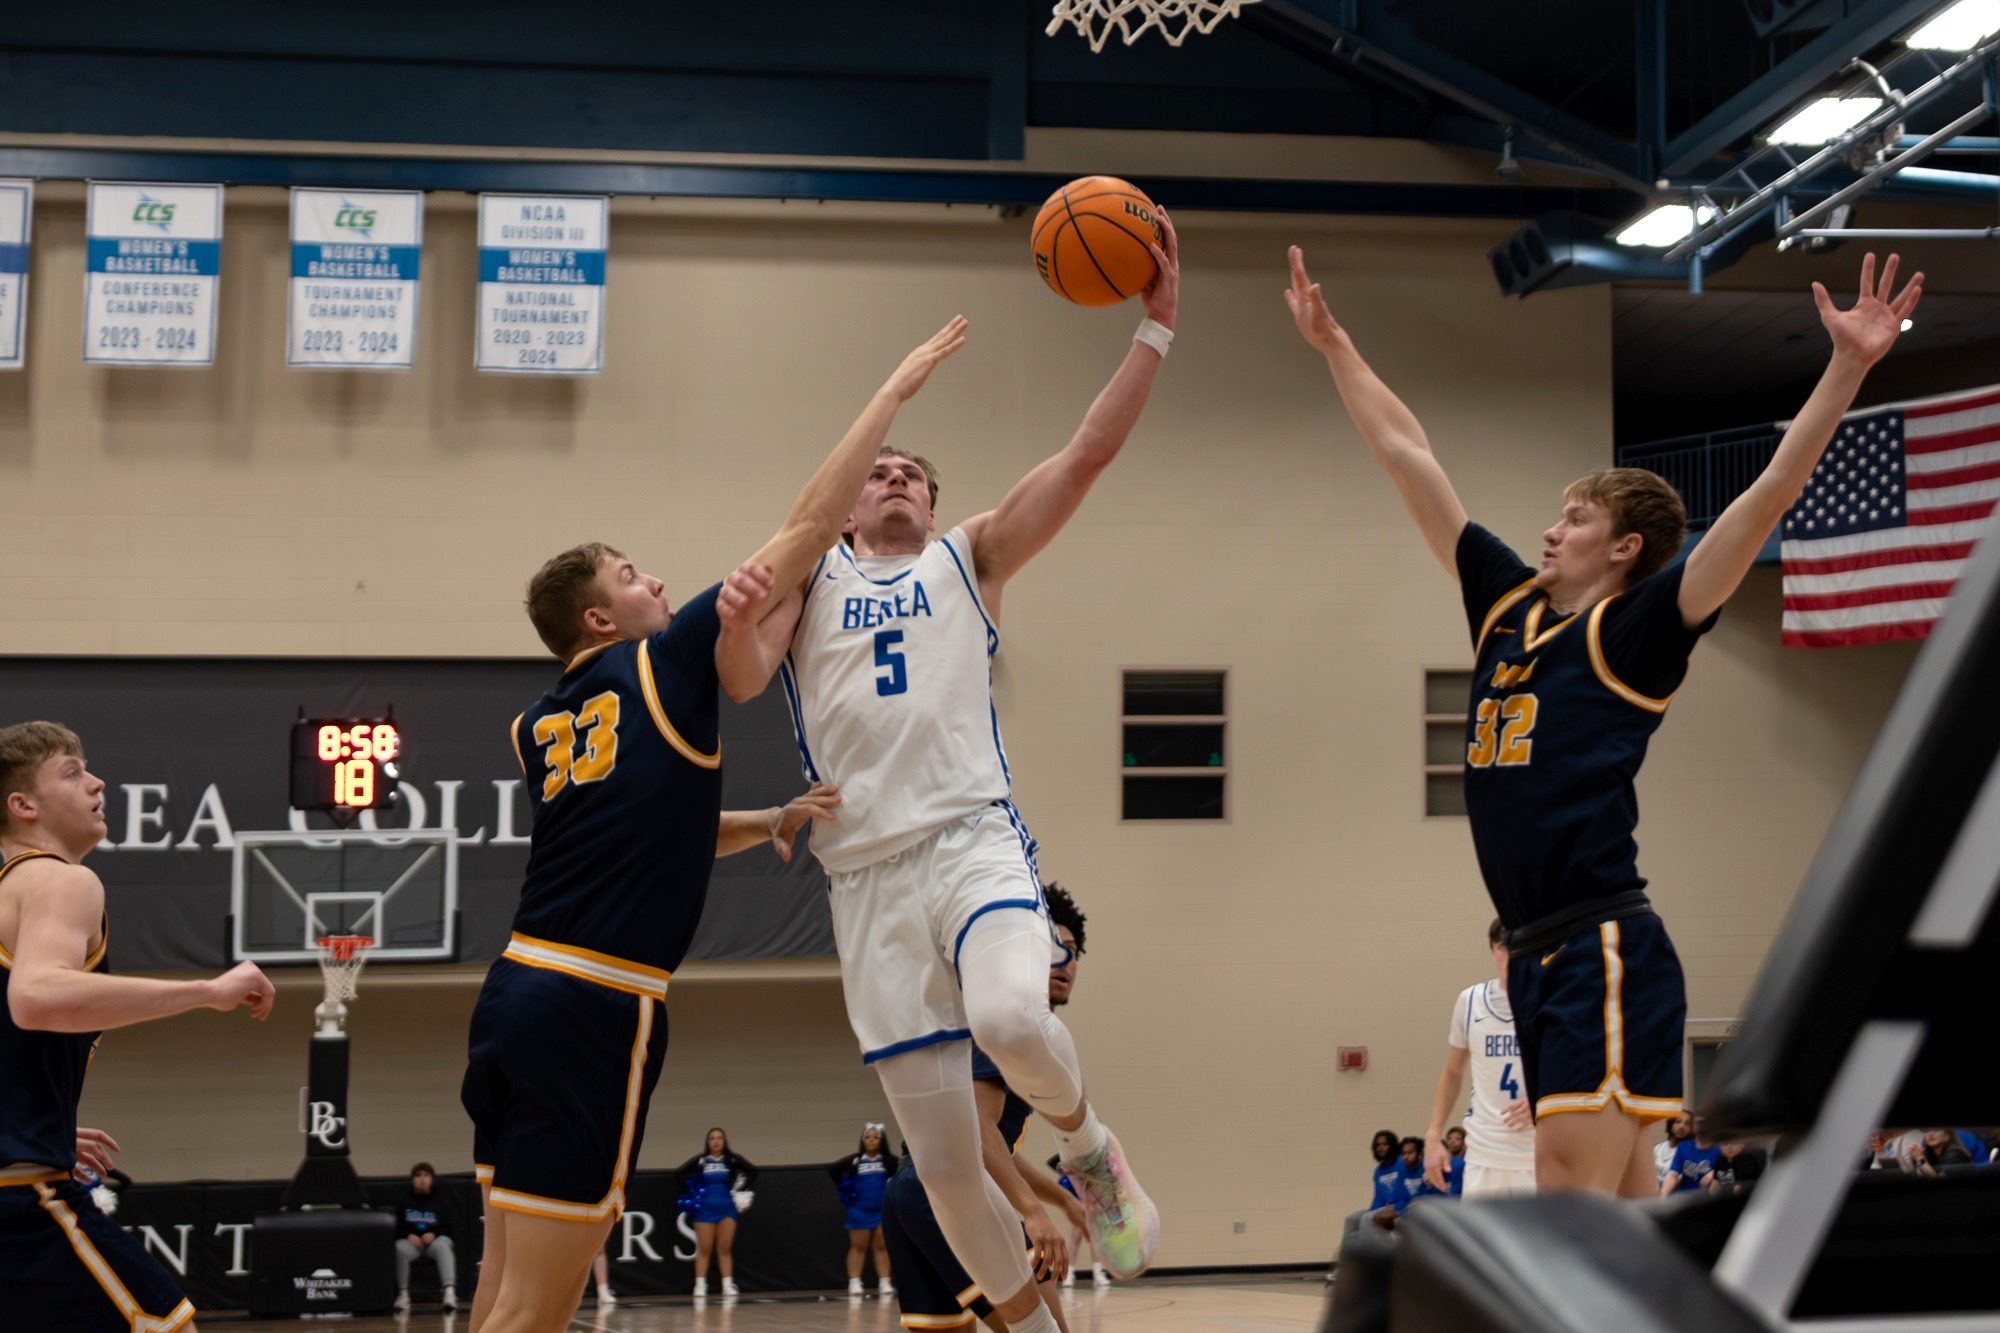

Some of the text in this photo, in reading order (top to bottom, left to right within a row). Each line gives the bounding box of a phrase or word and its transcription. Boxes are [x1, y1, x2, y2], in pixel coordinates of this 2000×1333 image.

[133, 203, 176, 221] CCS
[334, 210, 377, 228] CCS
[521, 205, 565, 222] NCAA
[501, 225, 584, 241] DIVISION III
[118, 240, 189, 256] WOMEN'S
[320, 246, 390, 261] WOMEN'S
[105, 257, 199, 273] BASKETBALL
[509, 251, 576, 266] WOMEN'S
[307, 262, 400, 278] BASKETBALL
[497, 267, 586, 283] BASKETBALL
[103, 281, 200, 297] CONFERENCE
[304, 286, 403, 301] TOURNAMENT
[106, 299, 195, 315] CHAMPIONS
[505, 291, 576, 307] NATIONAL
[309, 304, 397, 320] CHAMPIONS
[492, 308, 589, 324] TOURNAMENT
[100, 326, 140, 348] 2023
[156, 328, 196, 349] 2024
[303, 330, 343, 352] 2023
[359, 332, 399, 353] 2024
[546, 331, 585, 346] 2023
[518, 350, 556, 365] 2024
[873, 629, 908, 697] 5
[1467, 692, 1539, 768] 32
[318, 724, 396, 761] 8:58
[532, 689, 620, 803] 33
[334, 759, 374, 807] 18
[1499, 1063, 1518, 1099] 4
[305, 1288, 338, 1299] BANK
